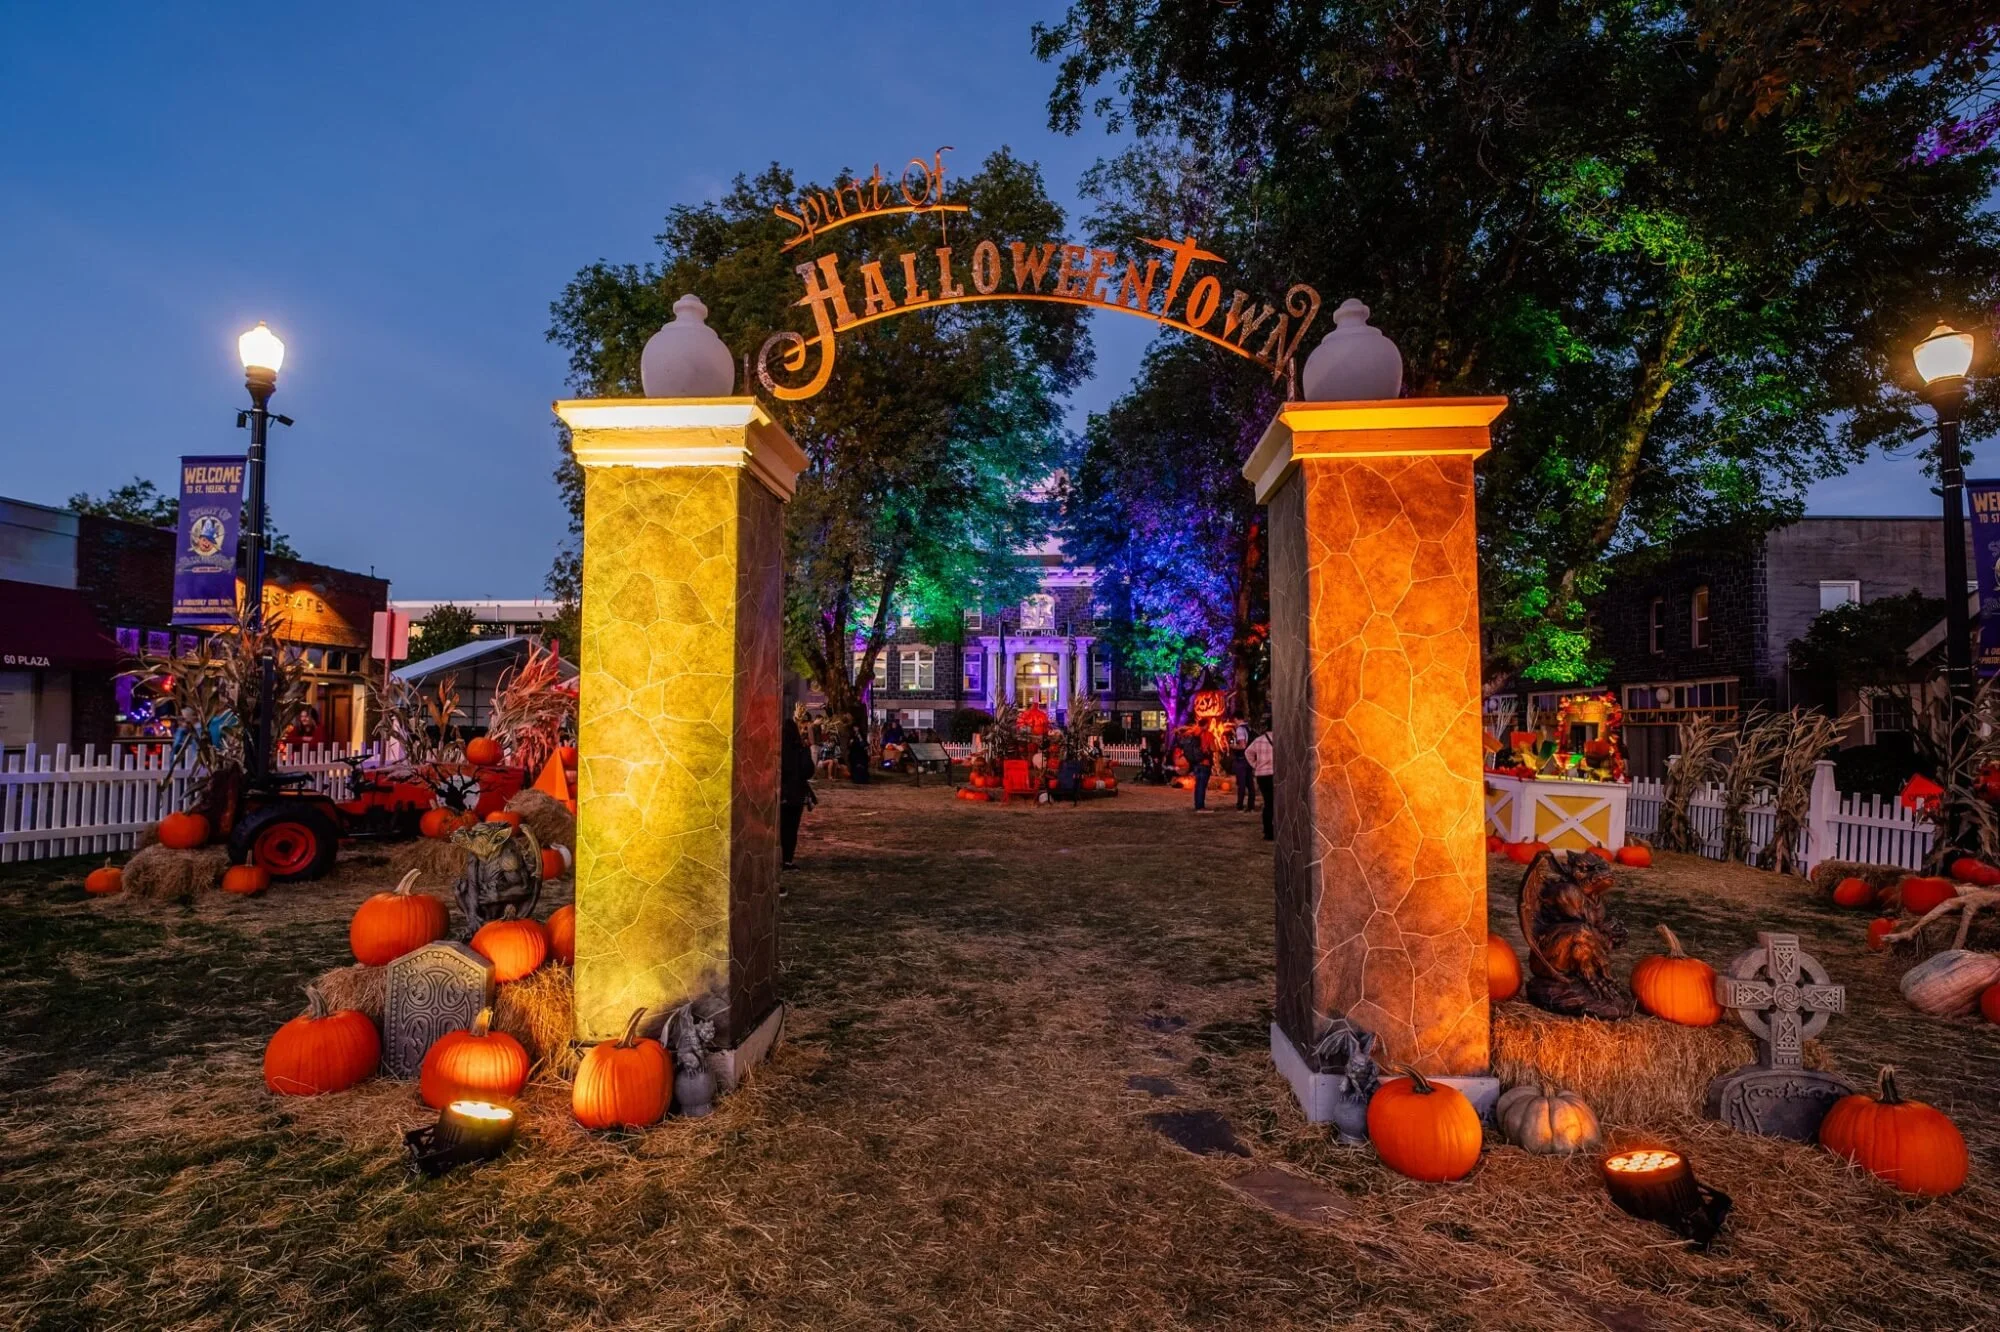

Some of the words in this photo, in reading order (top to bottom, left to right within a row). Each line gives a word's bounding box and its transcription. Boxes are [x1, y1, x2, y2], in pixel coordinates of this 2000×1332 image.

[774, 163, 890, 247] Spirit
[184, 466, 243, 485] WELCOME
[1978, 513, 1989, 524] TO
[1015, 629, 1033, 637] CITY
[1040, 629, 1059, 637] HALL
[4, 654, 16, 665] 60
[18, 655, 51, 667] PLAZA
